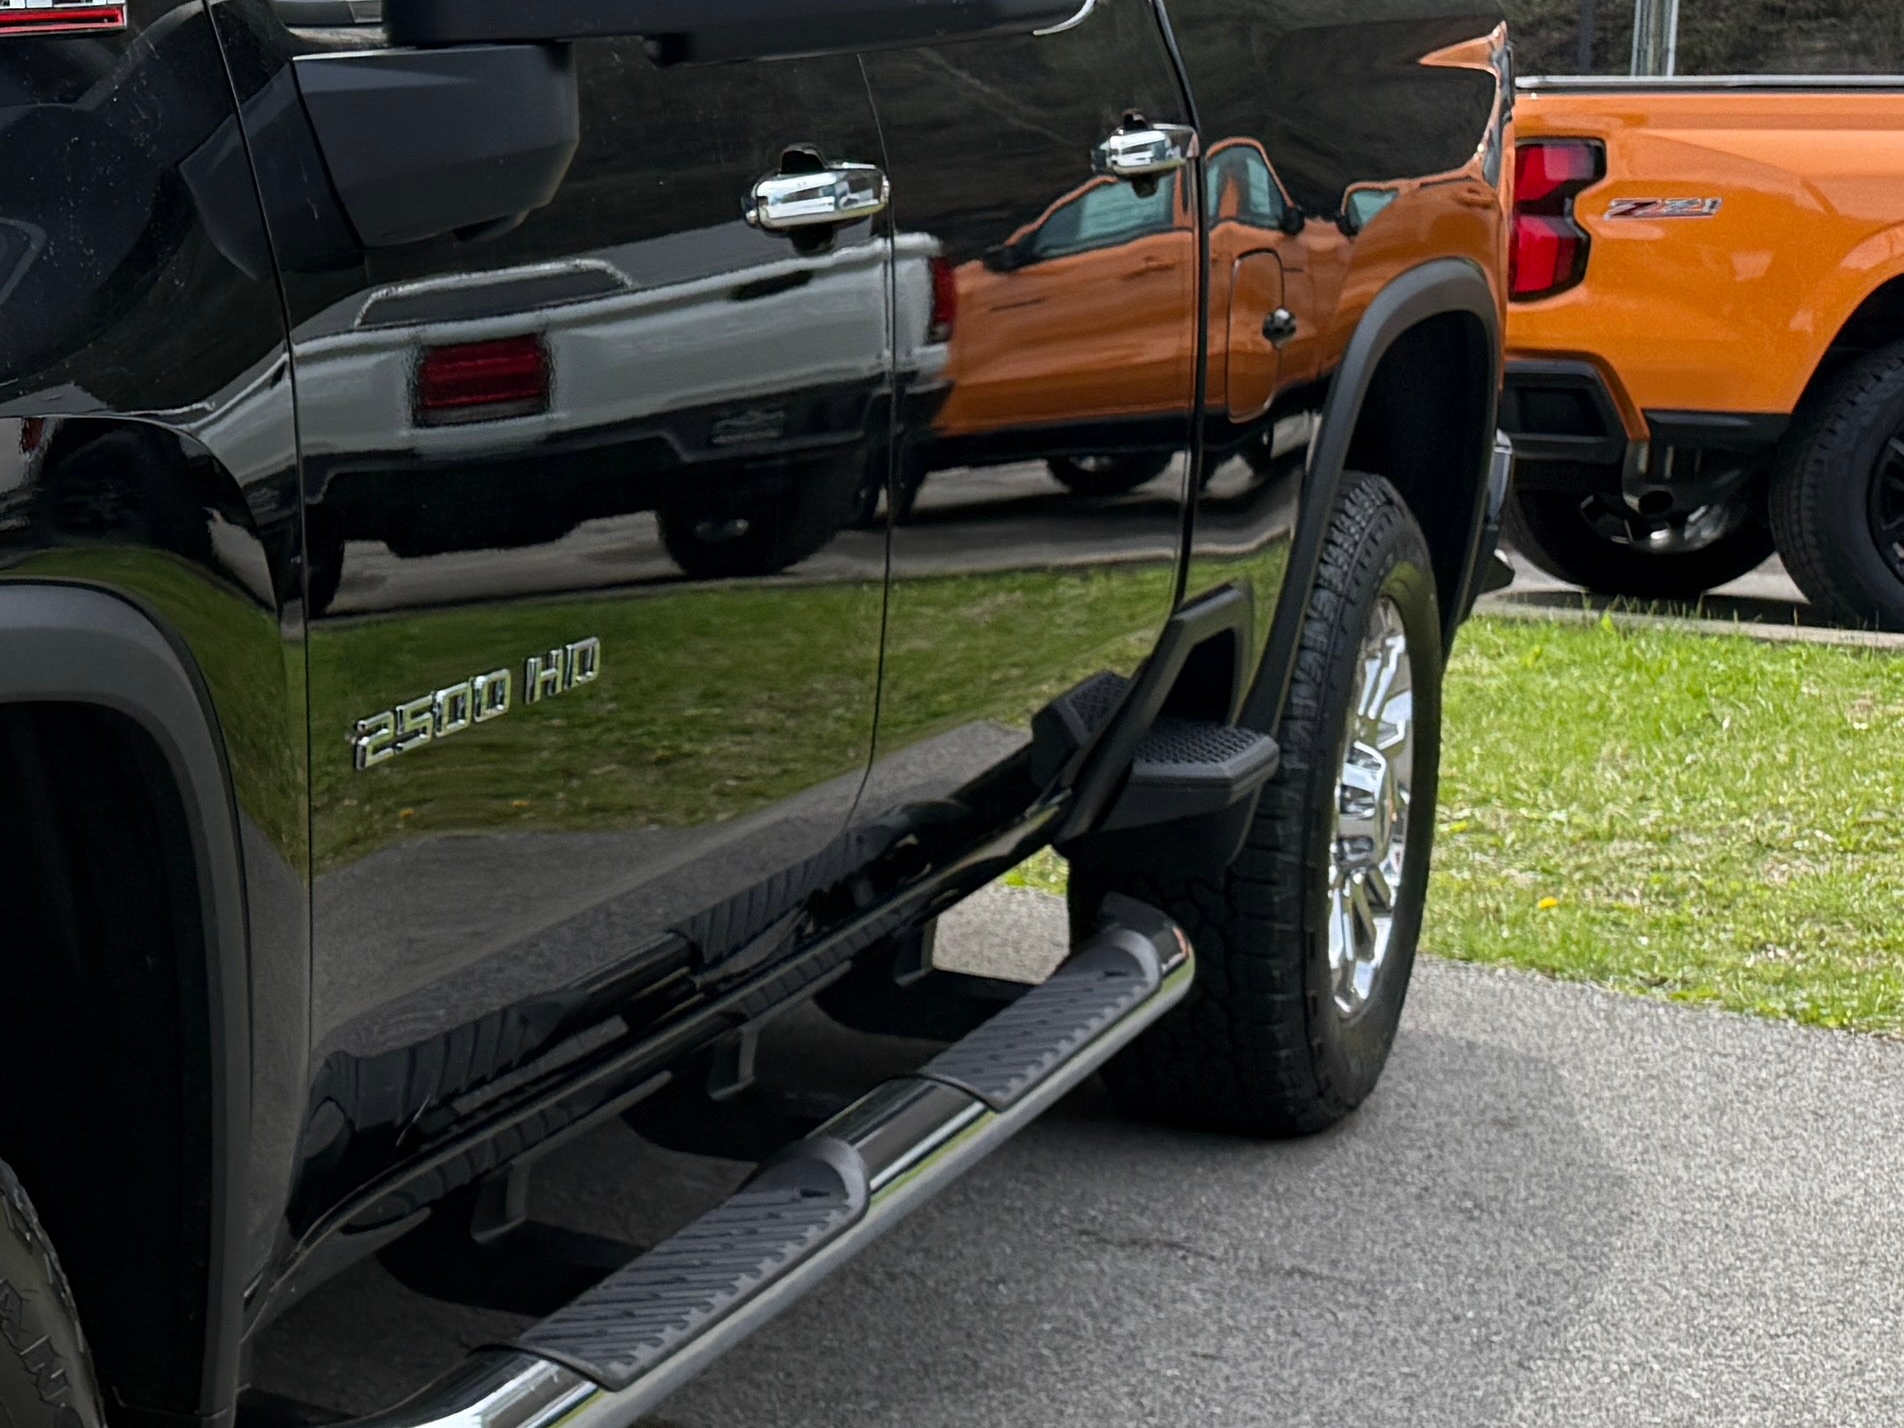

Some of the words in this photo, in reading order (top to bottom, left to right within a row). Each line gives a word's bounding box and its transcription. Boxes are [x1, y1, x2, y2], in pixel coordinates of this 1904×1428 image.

[1603, 197, 1723, 220] Z71
[350, 668, 512, 770] 2500
[524, 636, 601, 705] HD
